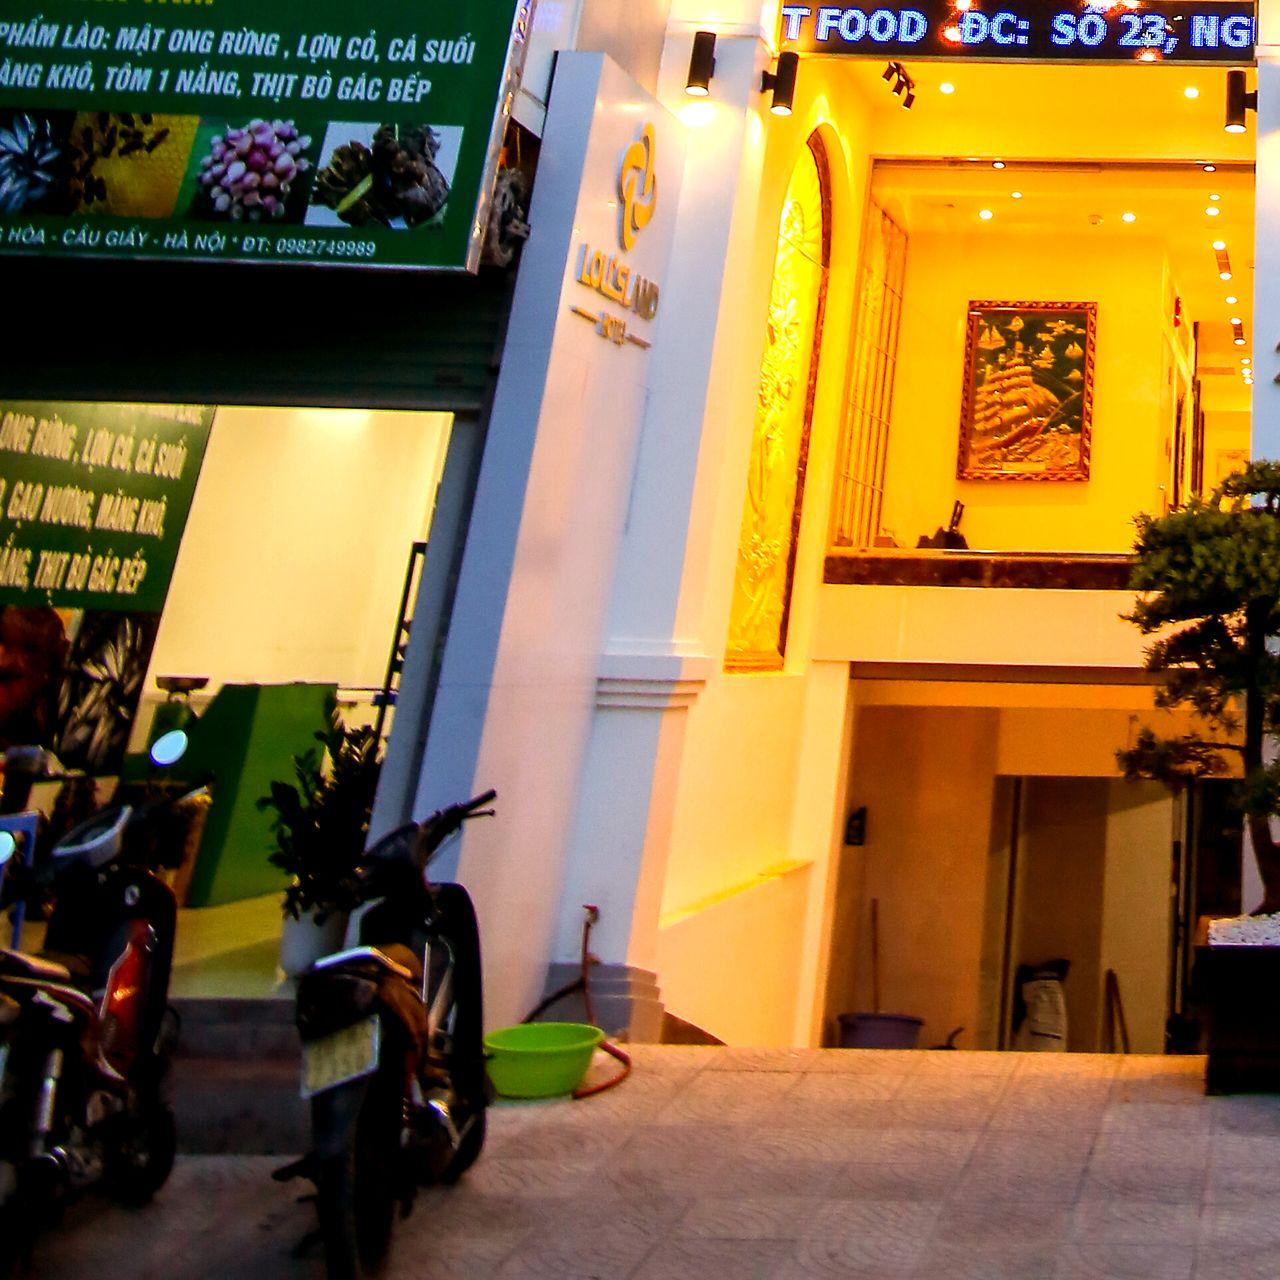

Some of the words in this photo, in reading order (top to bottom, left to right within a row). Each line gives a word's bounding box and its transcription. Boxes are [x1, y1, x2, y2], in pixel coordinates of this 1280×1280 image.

[115, 23, 165, 56] MẬT
[168, 28, 215, 54] ONG
[296, 33, 342, 64] LỢN
[387, 33, 417, 62] CÁ
[422, 32, 476, 64] SUỐI
[782, 7, 811, 41] T
[817, 7, 929, 43] FOOD
[104, 62, 152, 92] TÔM
[158, 68, 169, 92] 1
[251, 72, 298, 103] THỊT
[301, 69, 332, 99] BÒ
[337, 71, 382, 102] GÁC
[387, 71, 432, 103] BẾP
[164, 229, 188, 249] HÀ
[194, 230, 226, 253] NỘI
